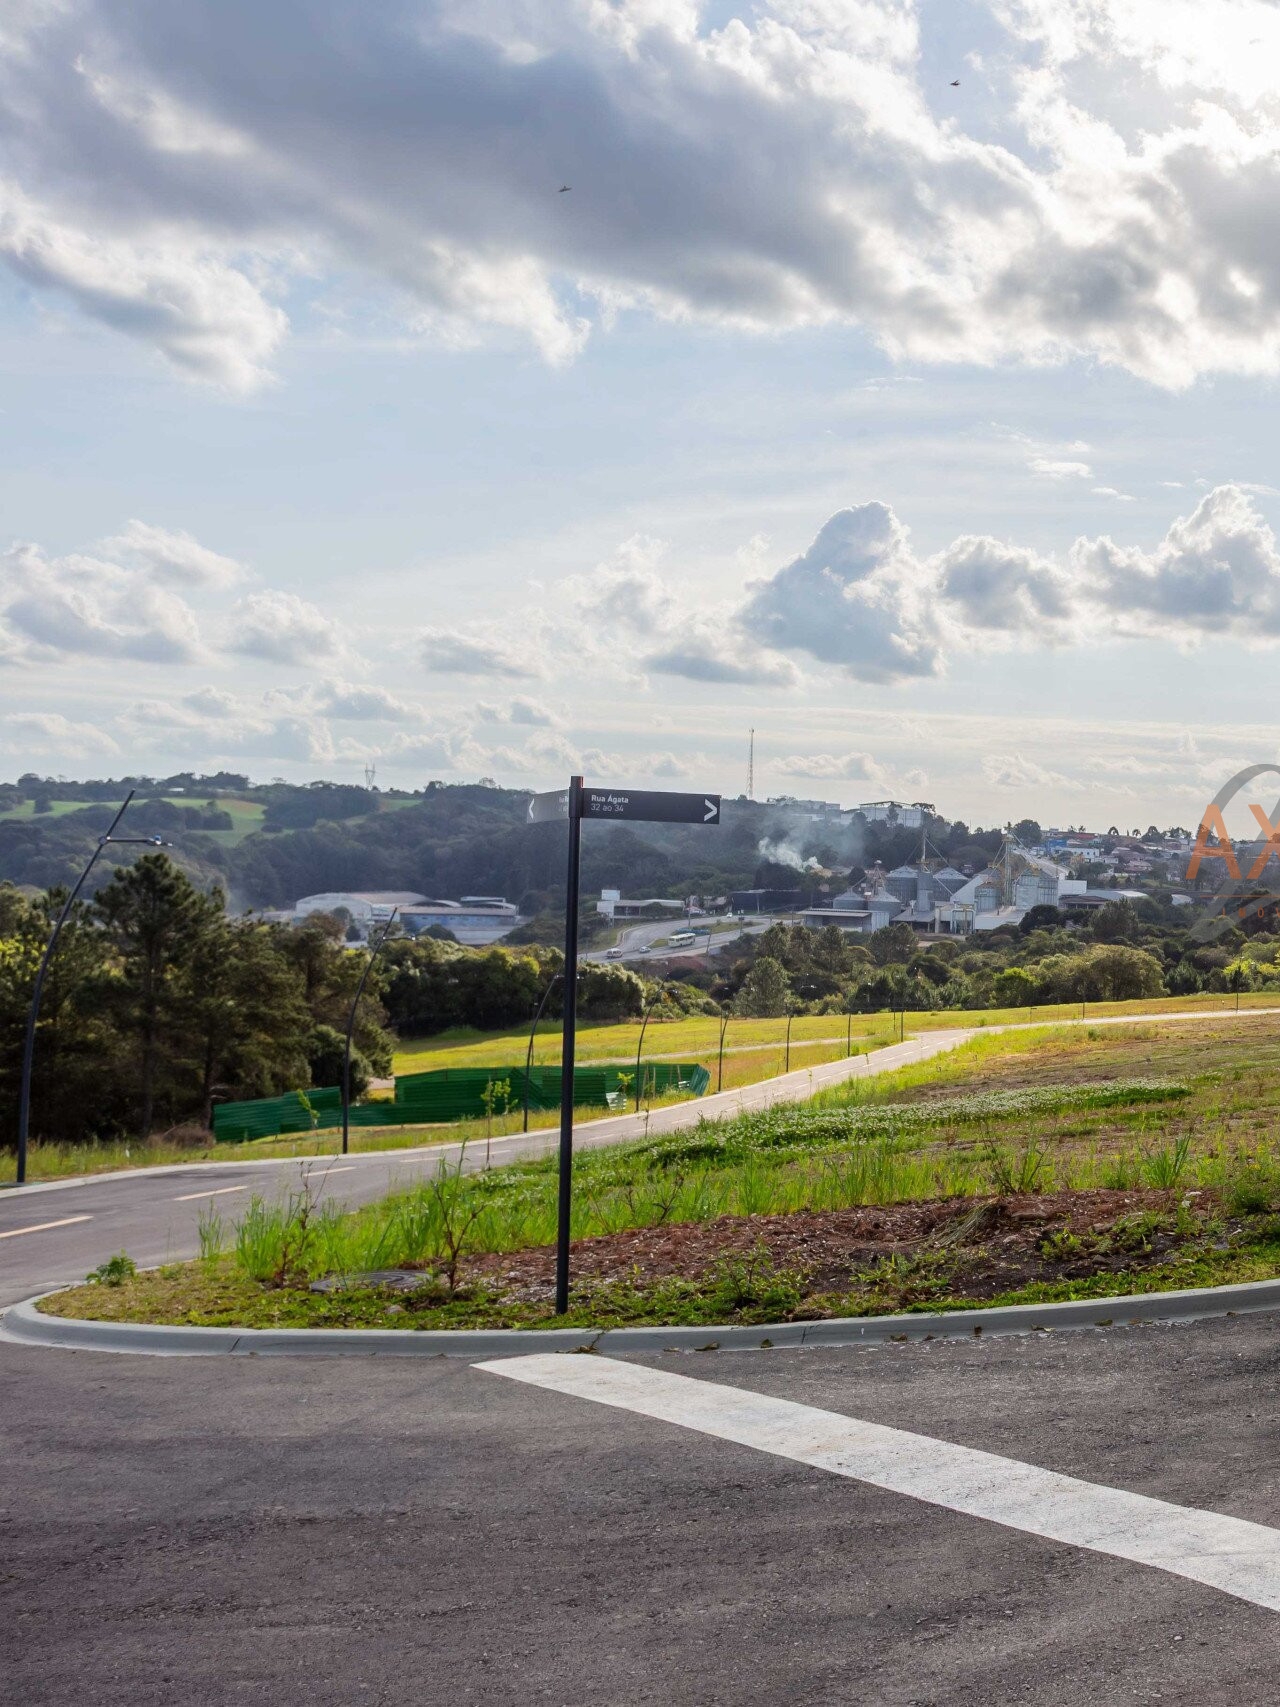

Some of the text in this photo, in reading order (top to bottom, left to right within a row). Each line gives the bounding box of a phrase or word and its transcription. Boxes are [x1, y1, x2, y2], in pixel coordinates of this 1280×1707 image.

[591, 794, 629, 804] Rua Ágata
[591, 803, 600, 811] 32
